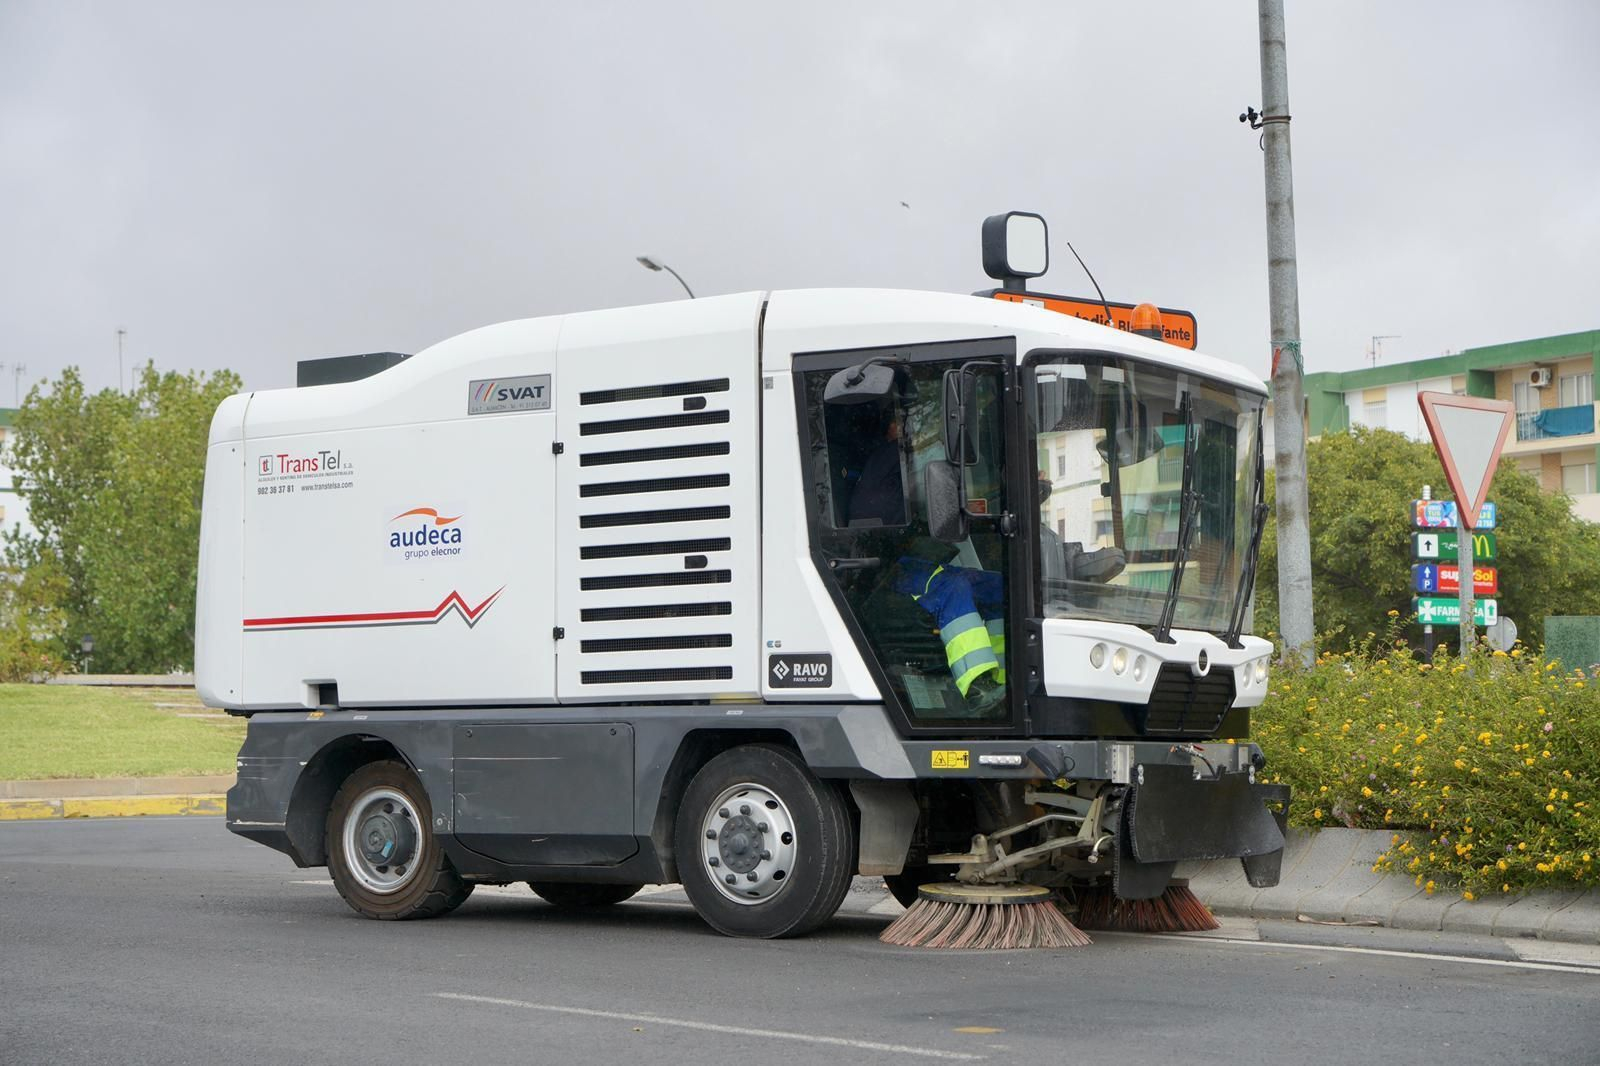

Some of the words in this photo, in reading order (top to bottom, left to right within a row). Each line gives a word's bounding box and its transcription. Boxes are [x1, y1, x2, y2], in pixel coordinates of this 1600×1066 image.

[497, 386, 545, 402] SVAT
[277, 449, 340, 473] TransTel
[278, 485, 286, 494] 37
[301, 481, 354, 491] www.transtelsa.com
[390, 524, 461, 548] audeca
[404, 550, 429, 560] grupo
[431, 546, 460, 556] elecnor
[793, 663, 828, 676] RAVO
